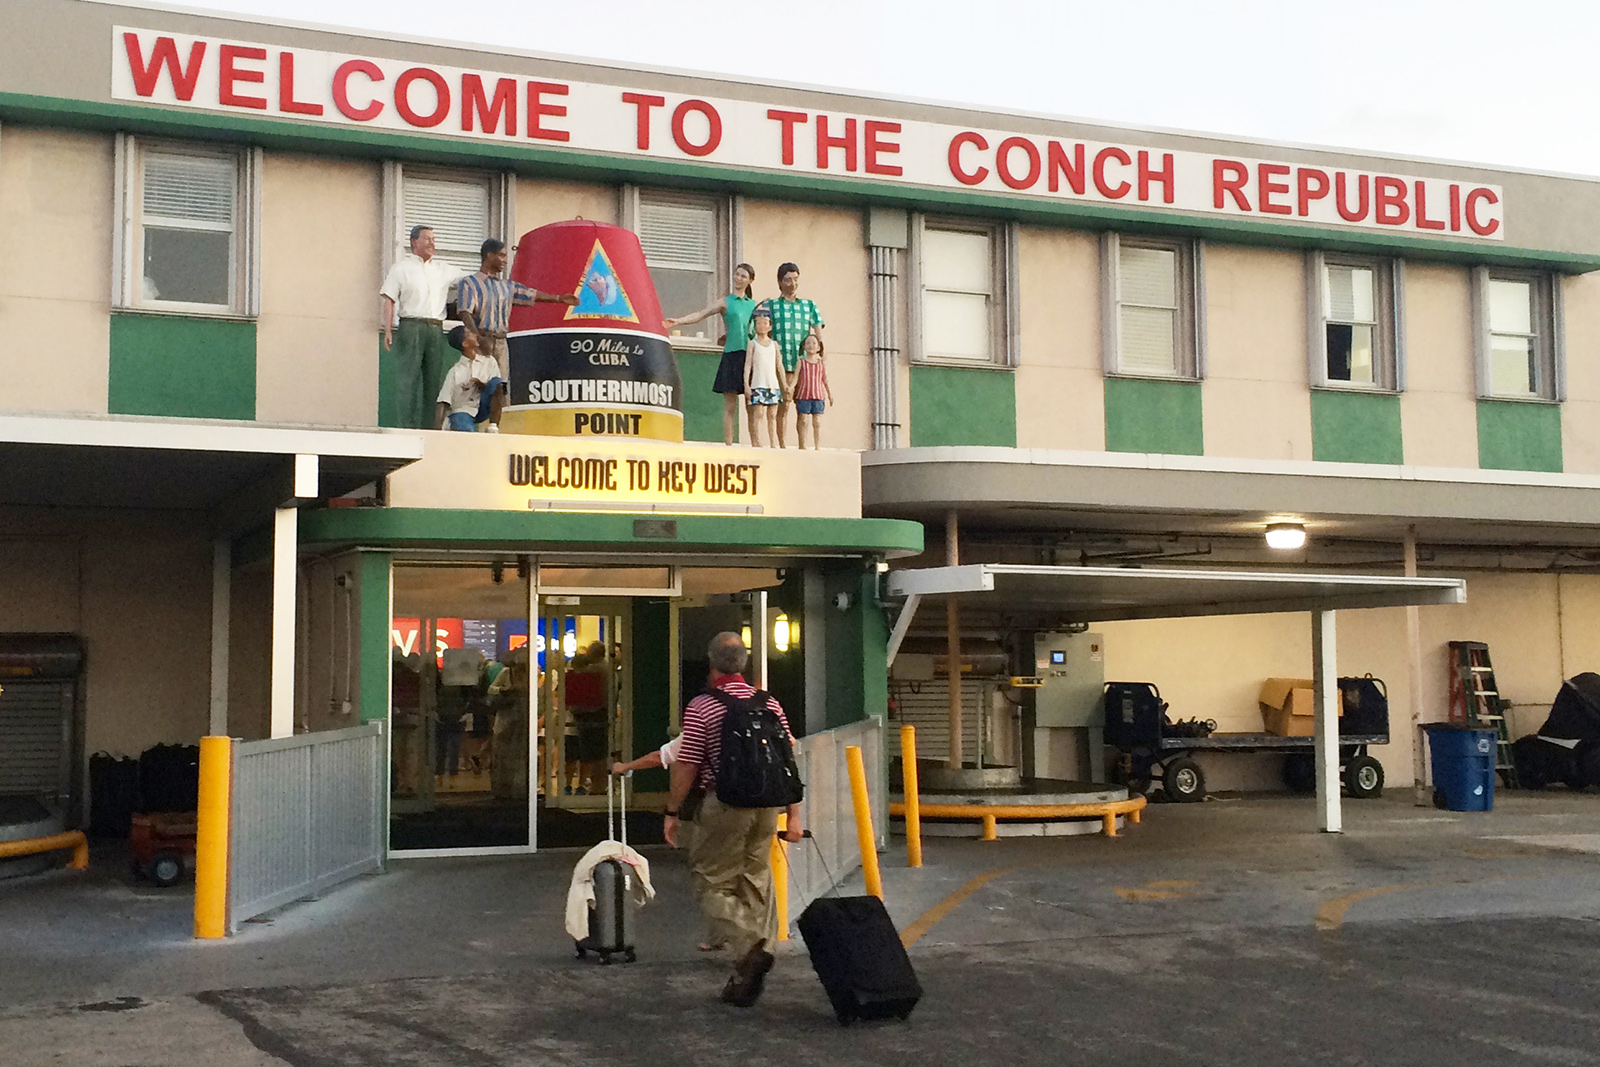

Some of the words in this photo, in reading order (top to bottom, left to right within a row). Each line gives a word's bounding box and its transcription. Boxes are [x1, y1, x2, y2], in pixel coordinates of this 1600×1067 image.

[123, 32, 570, 142] WELCOME
[622, 92, 723, 157] TO
[767, 109, 903, 177] THE
[947, 131, 1175, 204] CONCH
[1212, 159, 1500, 236] REPUBLIC
[569, 340, 594, 354] 90
[596, 338, 630, 354] Miles
[631, 343, 644, 356] to
[588, 353, 631, 367] CUBA
[528, 378, 674, 407] SOUTHERNMOST
[574, 412, 643, 436] POINT
[508, 453, 618, 491] WELCOME
[626, 459, 650, 491] TO
[657, 461, 698, 494] KEY
[703, 463, 761, 496] WEST
